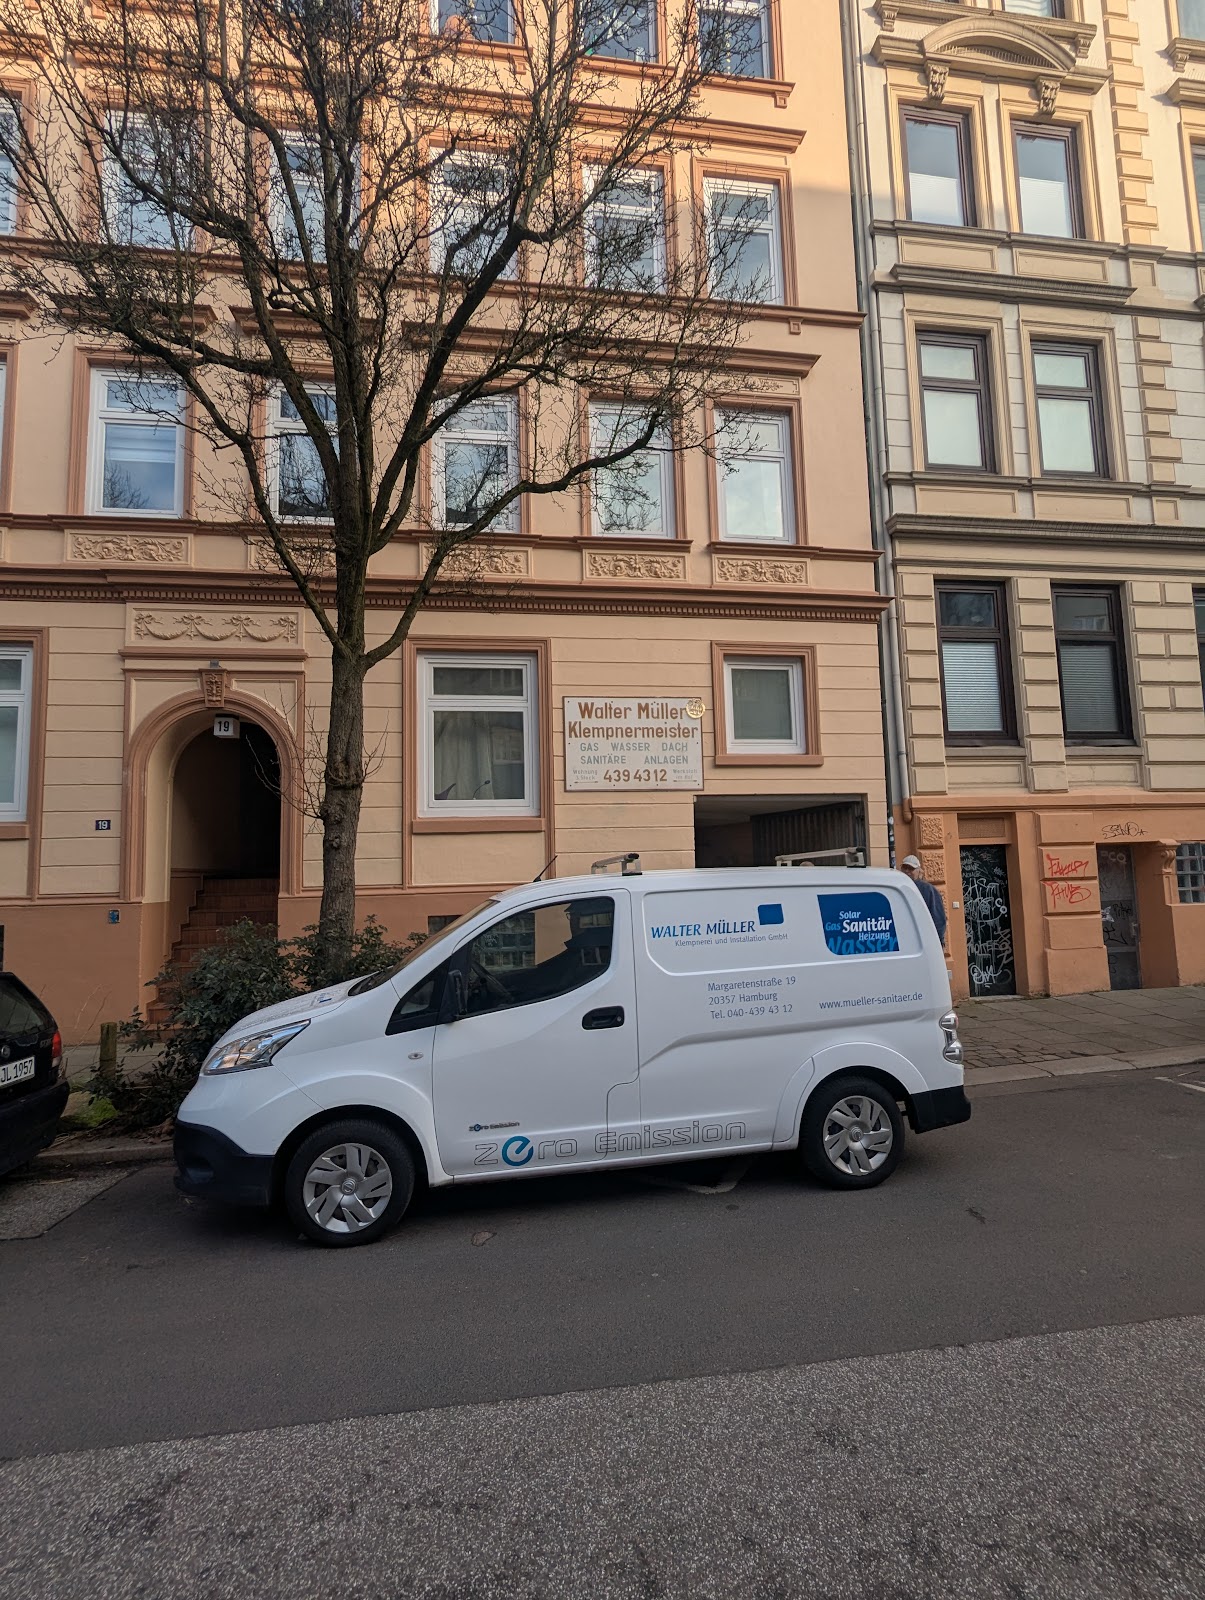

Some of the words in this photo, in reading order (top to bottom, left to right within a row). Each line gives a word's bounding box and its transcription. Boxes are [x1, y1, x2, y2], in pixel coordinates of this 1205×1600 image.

[578, 701, 632, 719] Walter
[637, 702, 688, 719] Müller
[217, 720, 230, 732] 19
[568, 721, 699, 740] Klempnermeister
[580, 742, 599, 752] GAS
[611, 742, 651, 752] WASSER
[662, 742, 688, 752] DACH
[580, 753, 627, 765] SANITÄRE
[644, 755, 689, 765] ANLAGEN
[98, 820, 108, 830] 19
[838, 910, 861, 920] Solar
[651, 923, 701, 938] WALTER
[706, 919, 756, 935] MÜLLER
[825, 922, 841, 931] Gas
[842, 916, 893, 933] Sanitär
[675, 937, 713, 947] Klempnerei
[730, 934, 767, 944] Installation
[768, 933, 788, 941] GmbH
[858, 931, 890, 941] Heizung
[707, 977, 783, 992] Margaretenstraße
[785, 975, 796, 985] 19
[708, 994, 736, 1006] 20357
[739, 992, 778, 1003] Hamburg
[819, 992, 923, 1009] www.mueller-sanitaer.de
[710, 1009, 726, 1020] Tel.
[768, 1005, 780, 1014] 43
[782, 1003, 793, 1013] 12
[1, 1067, 12, 1083] JL
[13, 1059, 33, 1079] 1957
